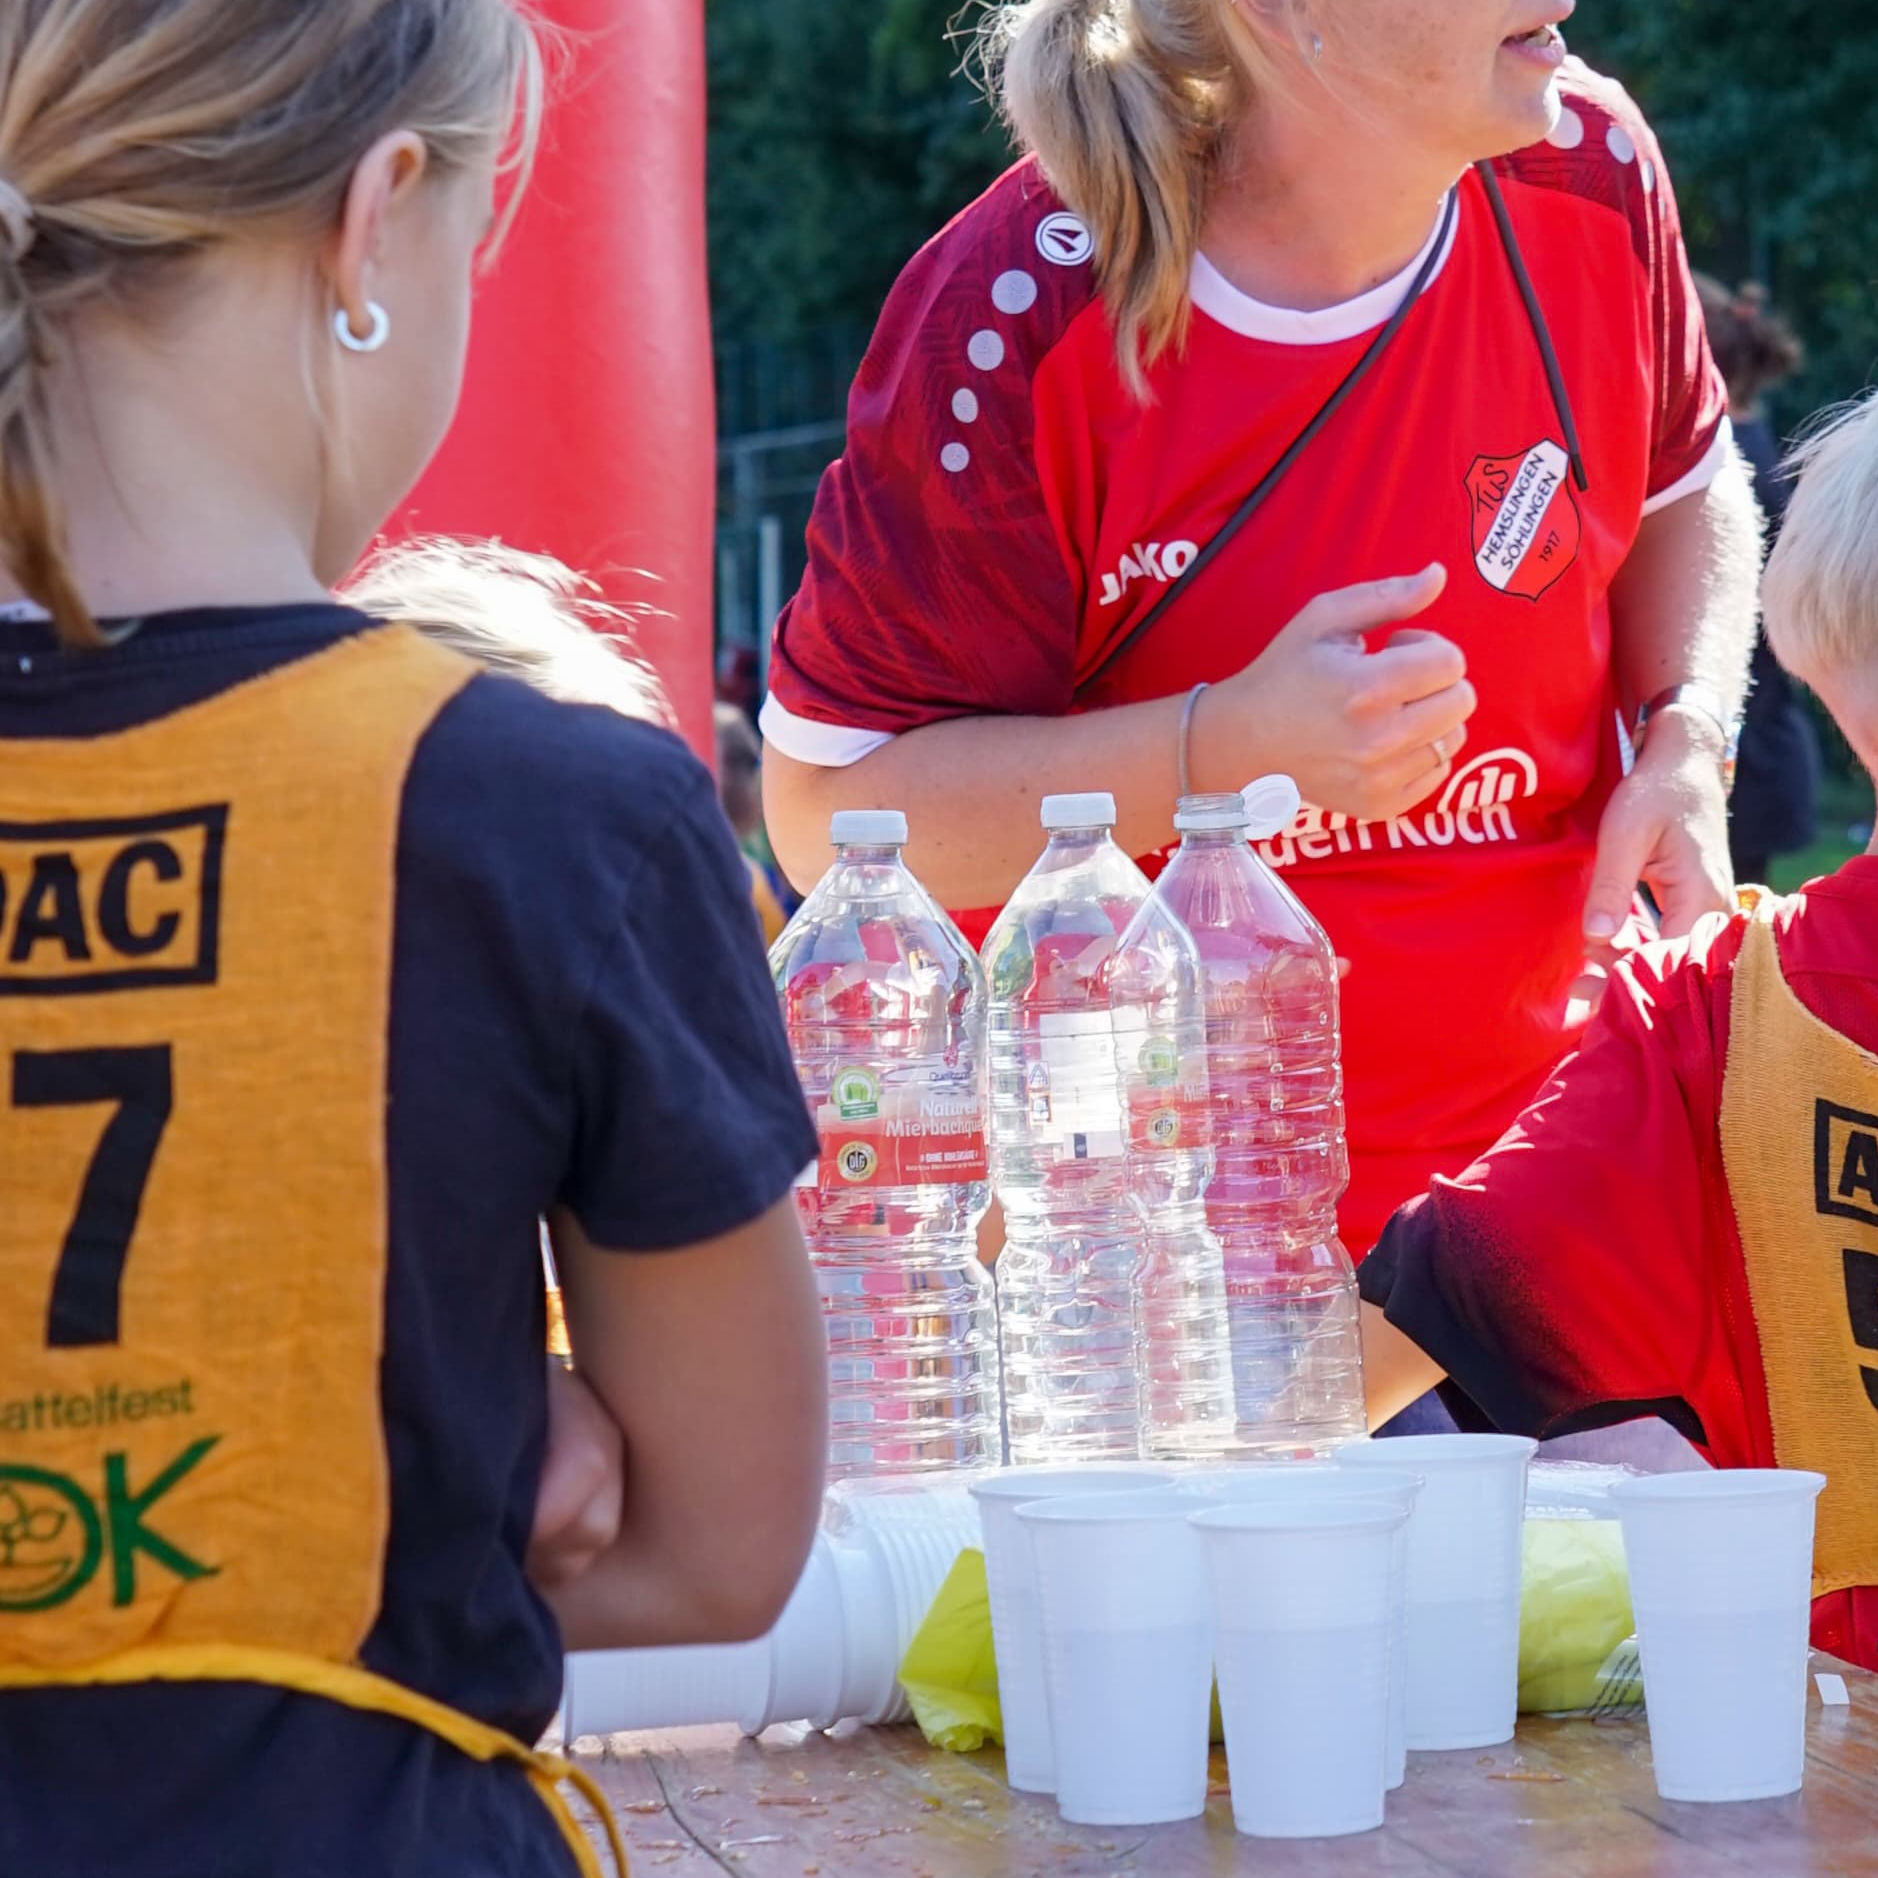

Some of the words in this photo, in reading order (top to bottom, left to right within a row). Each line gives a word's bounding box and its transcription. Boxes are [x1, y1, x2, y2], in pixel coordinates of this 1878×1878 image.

[1481, 453, 1545, 565] HEMSLINGEN
[1500, 471, 1559, 571] SÖHLINGEN
[1538, 530, 1561, 562] 1917
[1098, 539, 1199, 606] JAKO
[0, 839, 184, 963] AC
[11, 1043, 174, 1348] 7
